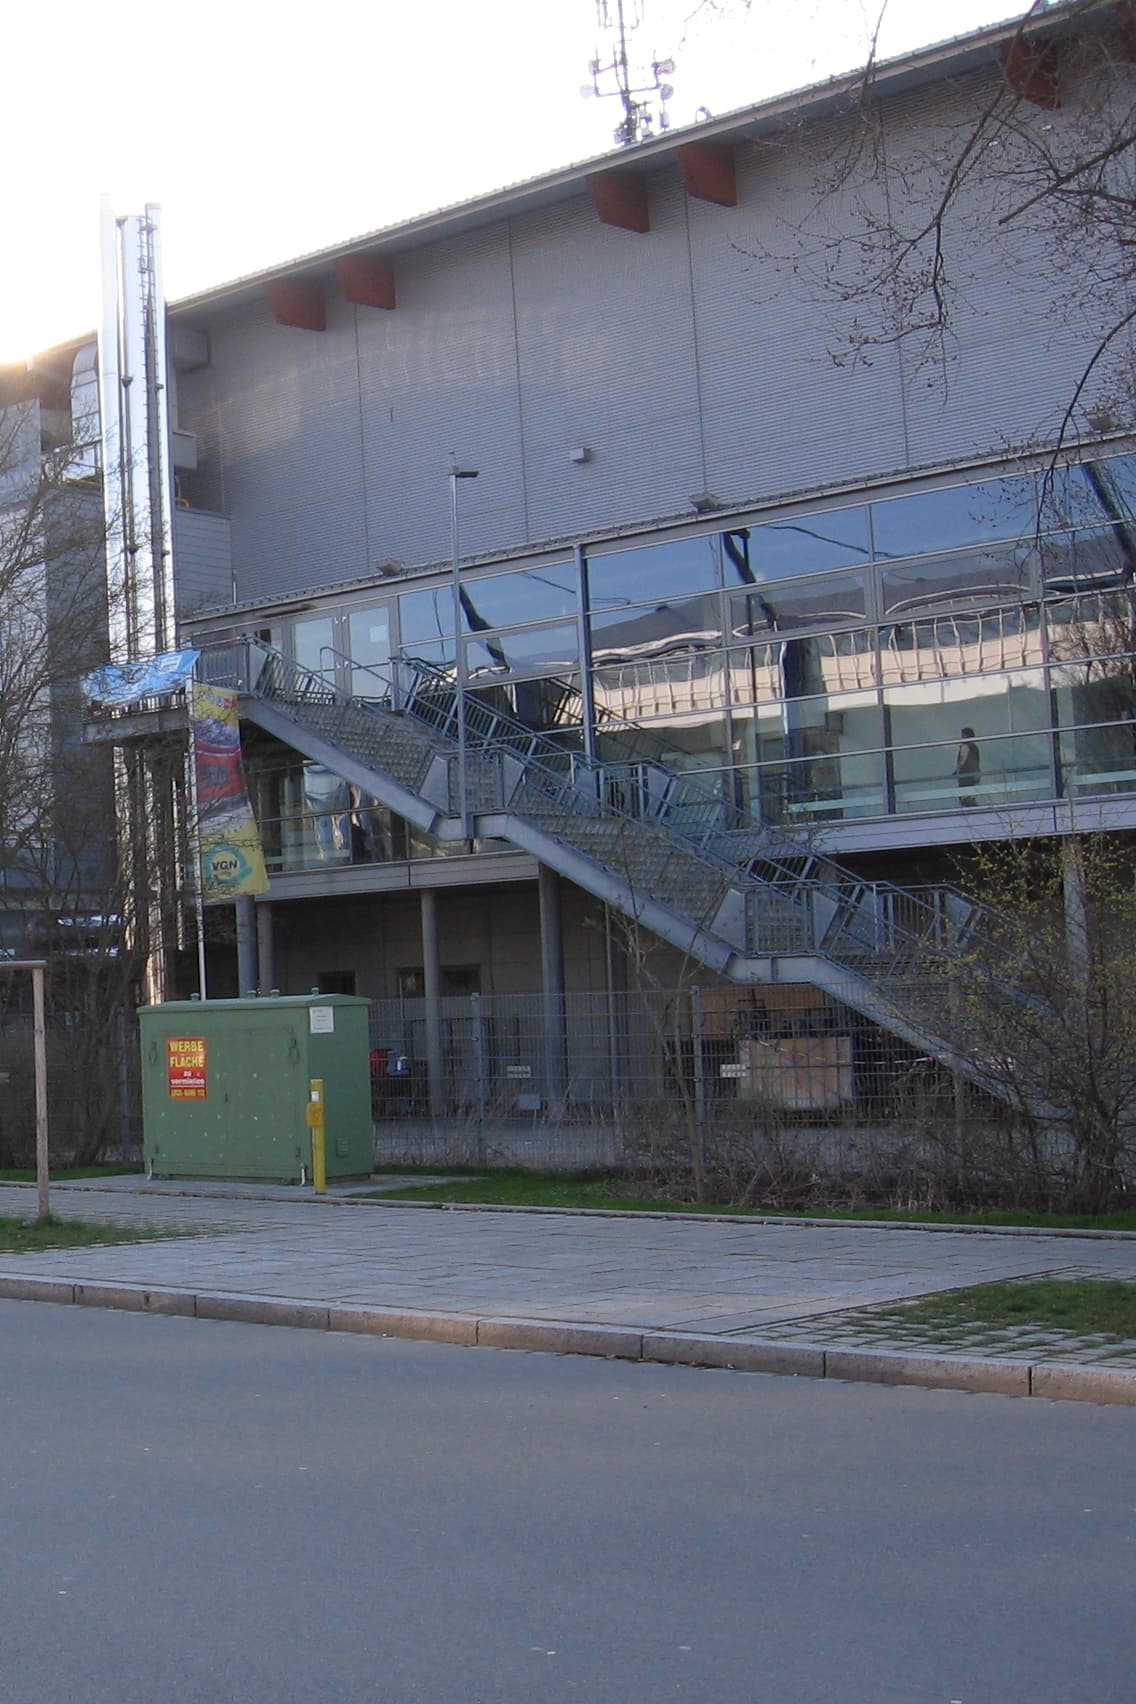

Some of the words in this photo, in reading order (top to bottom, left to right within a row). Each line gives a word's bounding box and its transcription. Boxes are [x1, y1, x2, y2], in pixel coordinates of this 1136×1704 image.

[211, 859, 238, 871] VGN
[169, 1040, 204, 1052] WERBE
[169, 1053, 205, 1067] FLÄCHE
